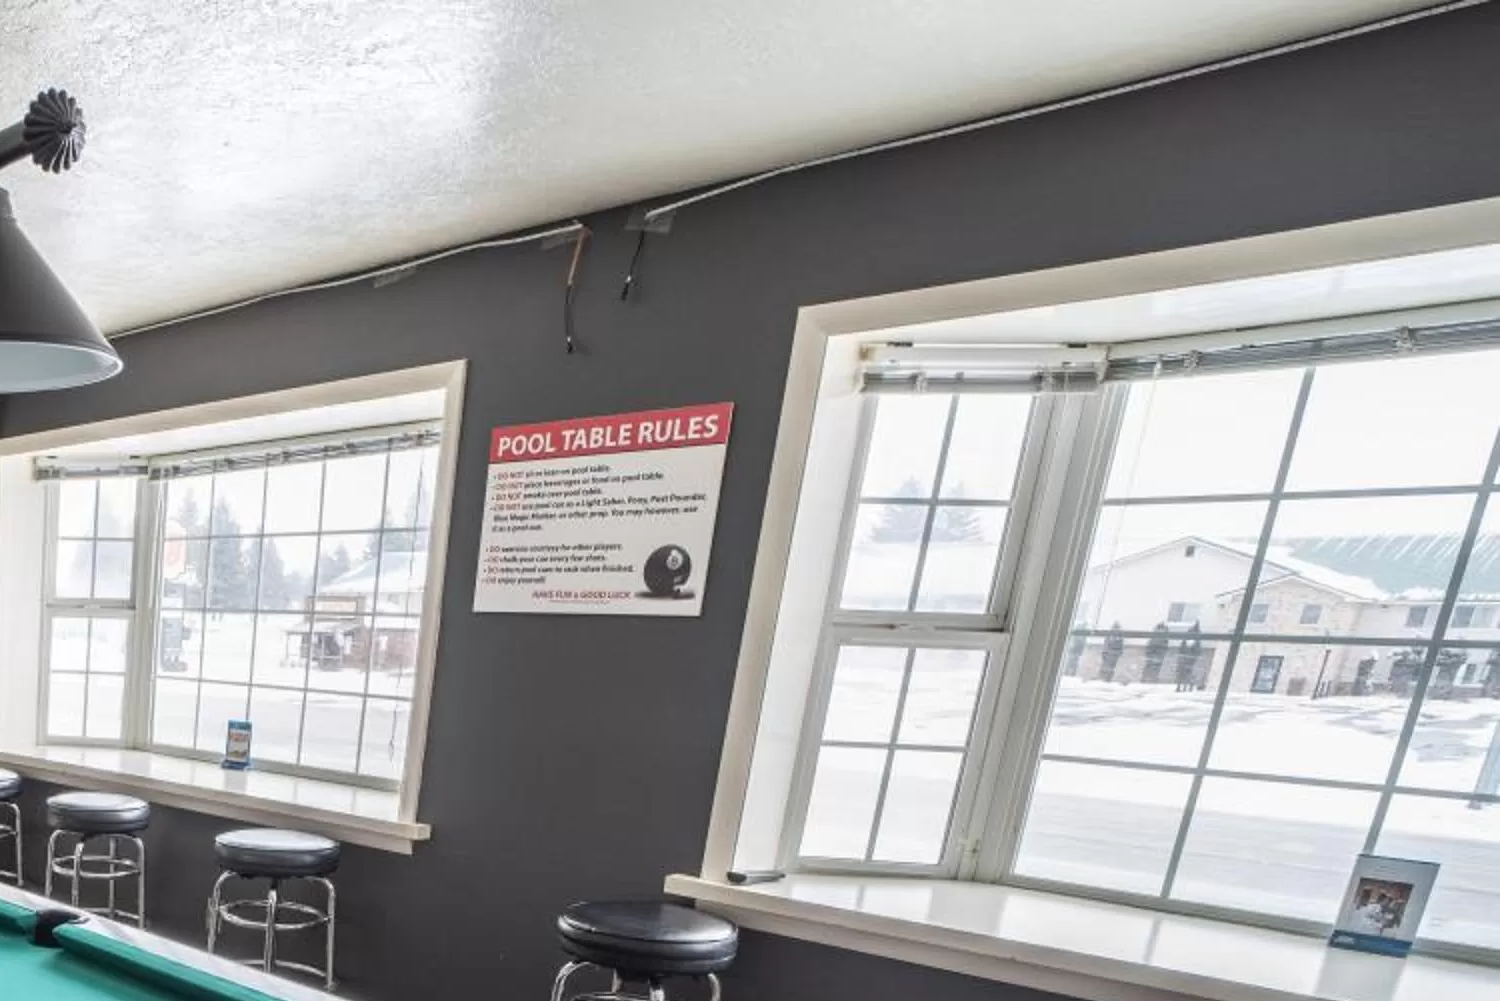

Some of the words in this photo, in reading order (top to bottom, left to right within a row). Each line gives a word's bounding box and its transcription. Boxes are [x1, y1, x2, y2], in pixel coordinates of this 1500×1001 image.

[497, 431, 557, 458] POOL
[561, 423, 632, 451] TABLE
[638, 414, 720, 444] RULES
